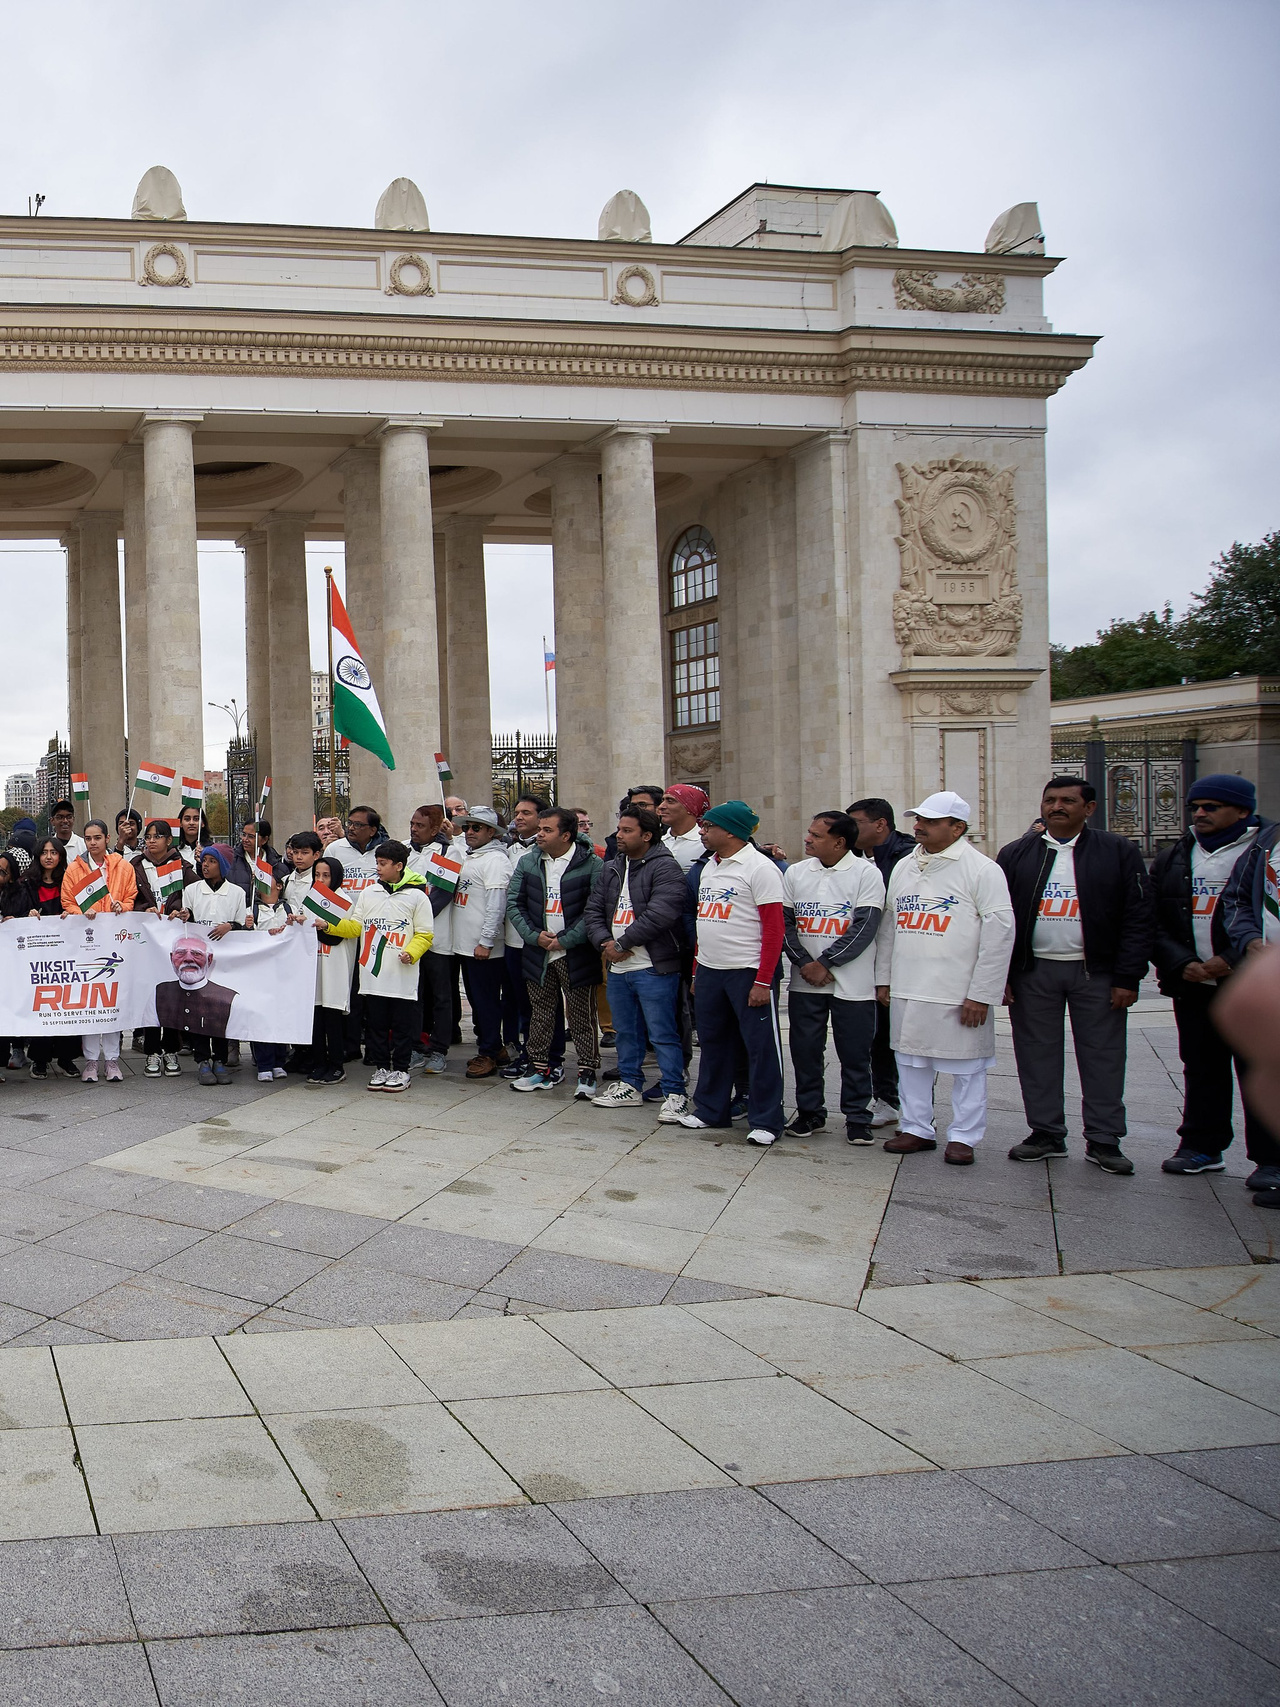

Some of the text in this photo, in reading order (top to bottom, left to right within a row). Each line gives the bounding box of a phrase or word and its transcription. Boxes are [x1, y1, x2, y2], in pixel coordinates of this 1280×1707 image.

[943, 582, 975, 593] 1955
[1044, 890, 1072, 898] RAT
[1192, 887, 1218, 895] RAT
[697, 902, 733, 919] UN
[796, 917, 850, 936] RUN
[895, 911, 952, 932] RUN
[29, 960, 76, 973] VIKSIT
[30, 971, 90, 985] BHARAT
[32, 981, 119, 1012] RUN
